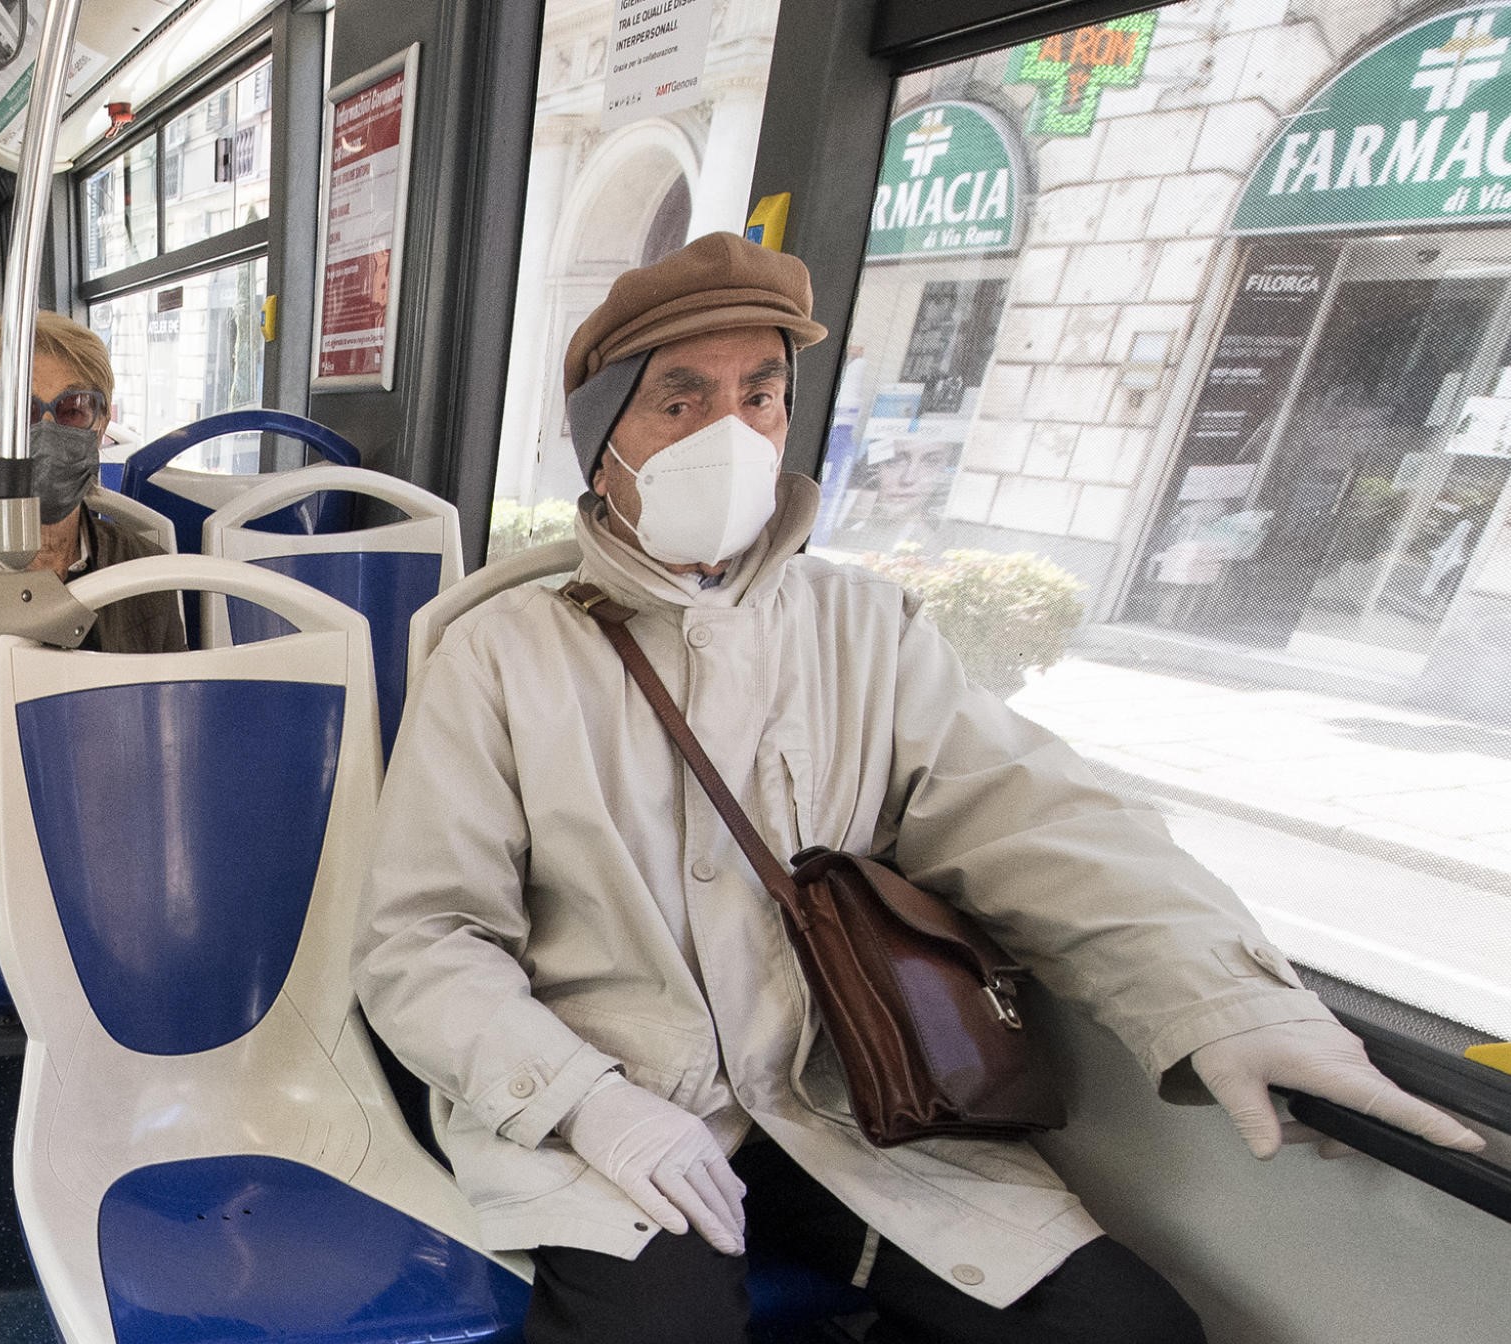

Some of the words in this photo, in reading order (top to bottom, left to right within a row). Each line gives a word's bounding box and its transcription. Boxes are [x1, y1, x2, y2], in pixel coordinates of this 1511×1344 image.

[619, 17, 631, 32] TRA
[632, 13, 641, 26] LE
[642, 6, 663, 21] QUALI
[663, 1, 673, 13] LE
[628, 60, 636, 70] per
[1268, 110, 1511, 196] FARMAC
[871, 168, 1010, 231] RMACIA
[1442, 185, 1472, 212] di
[922, 230, 938, 248] di
[940, 226, 962, 246] Via
[964, 225, 1004, 246] Roma
[1245, 274, 1321, 292] FILORGA
